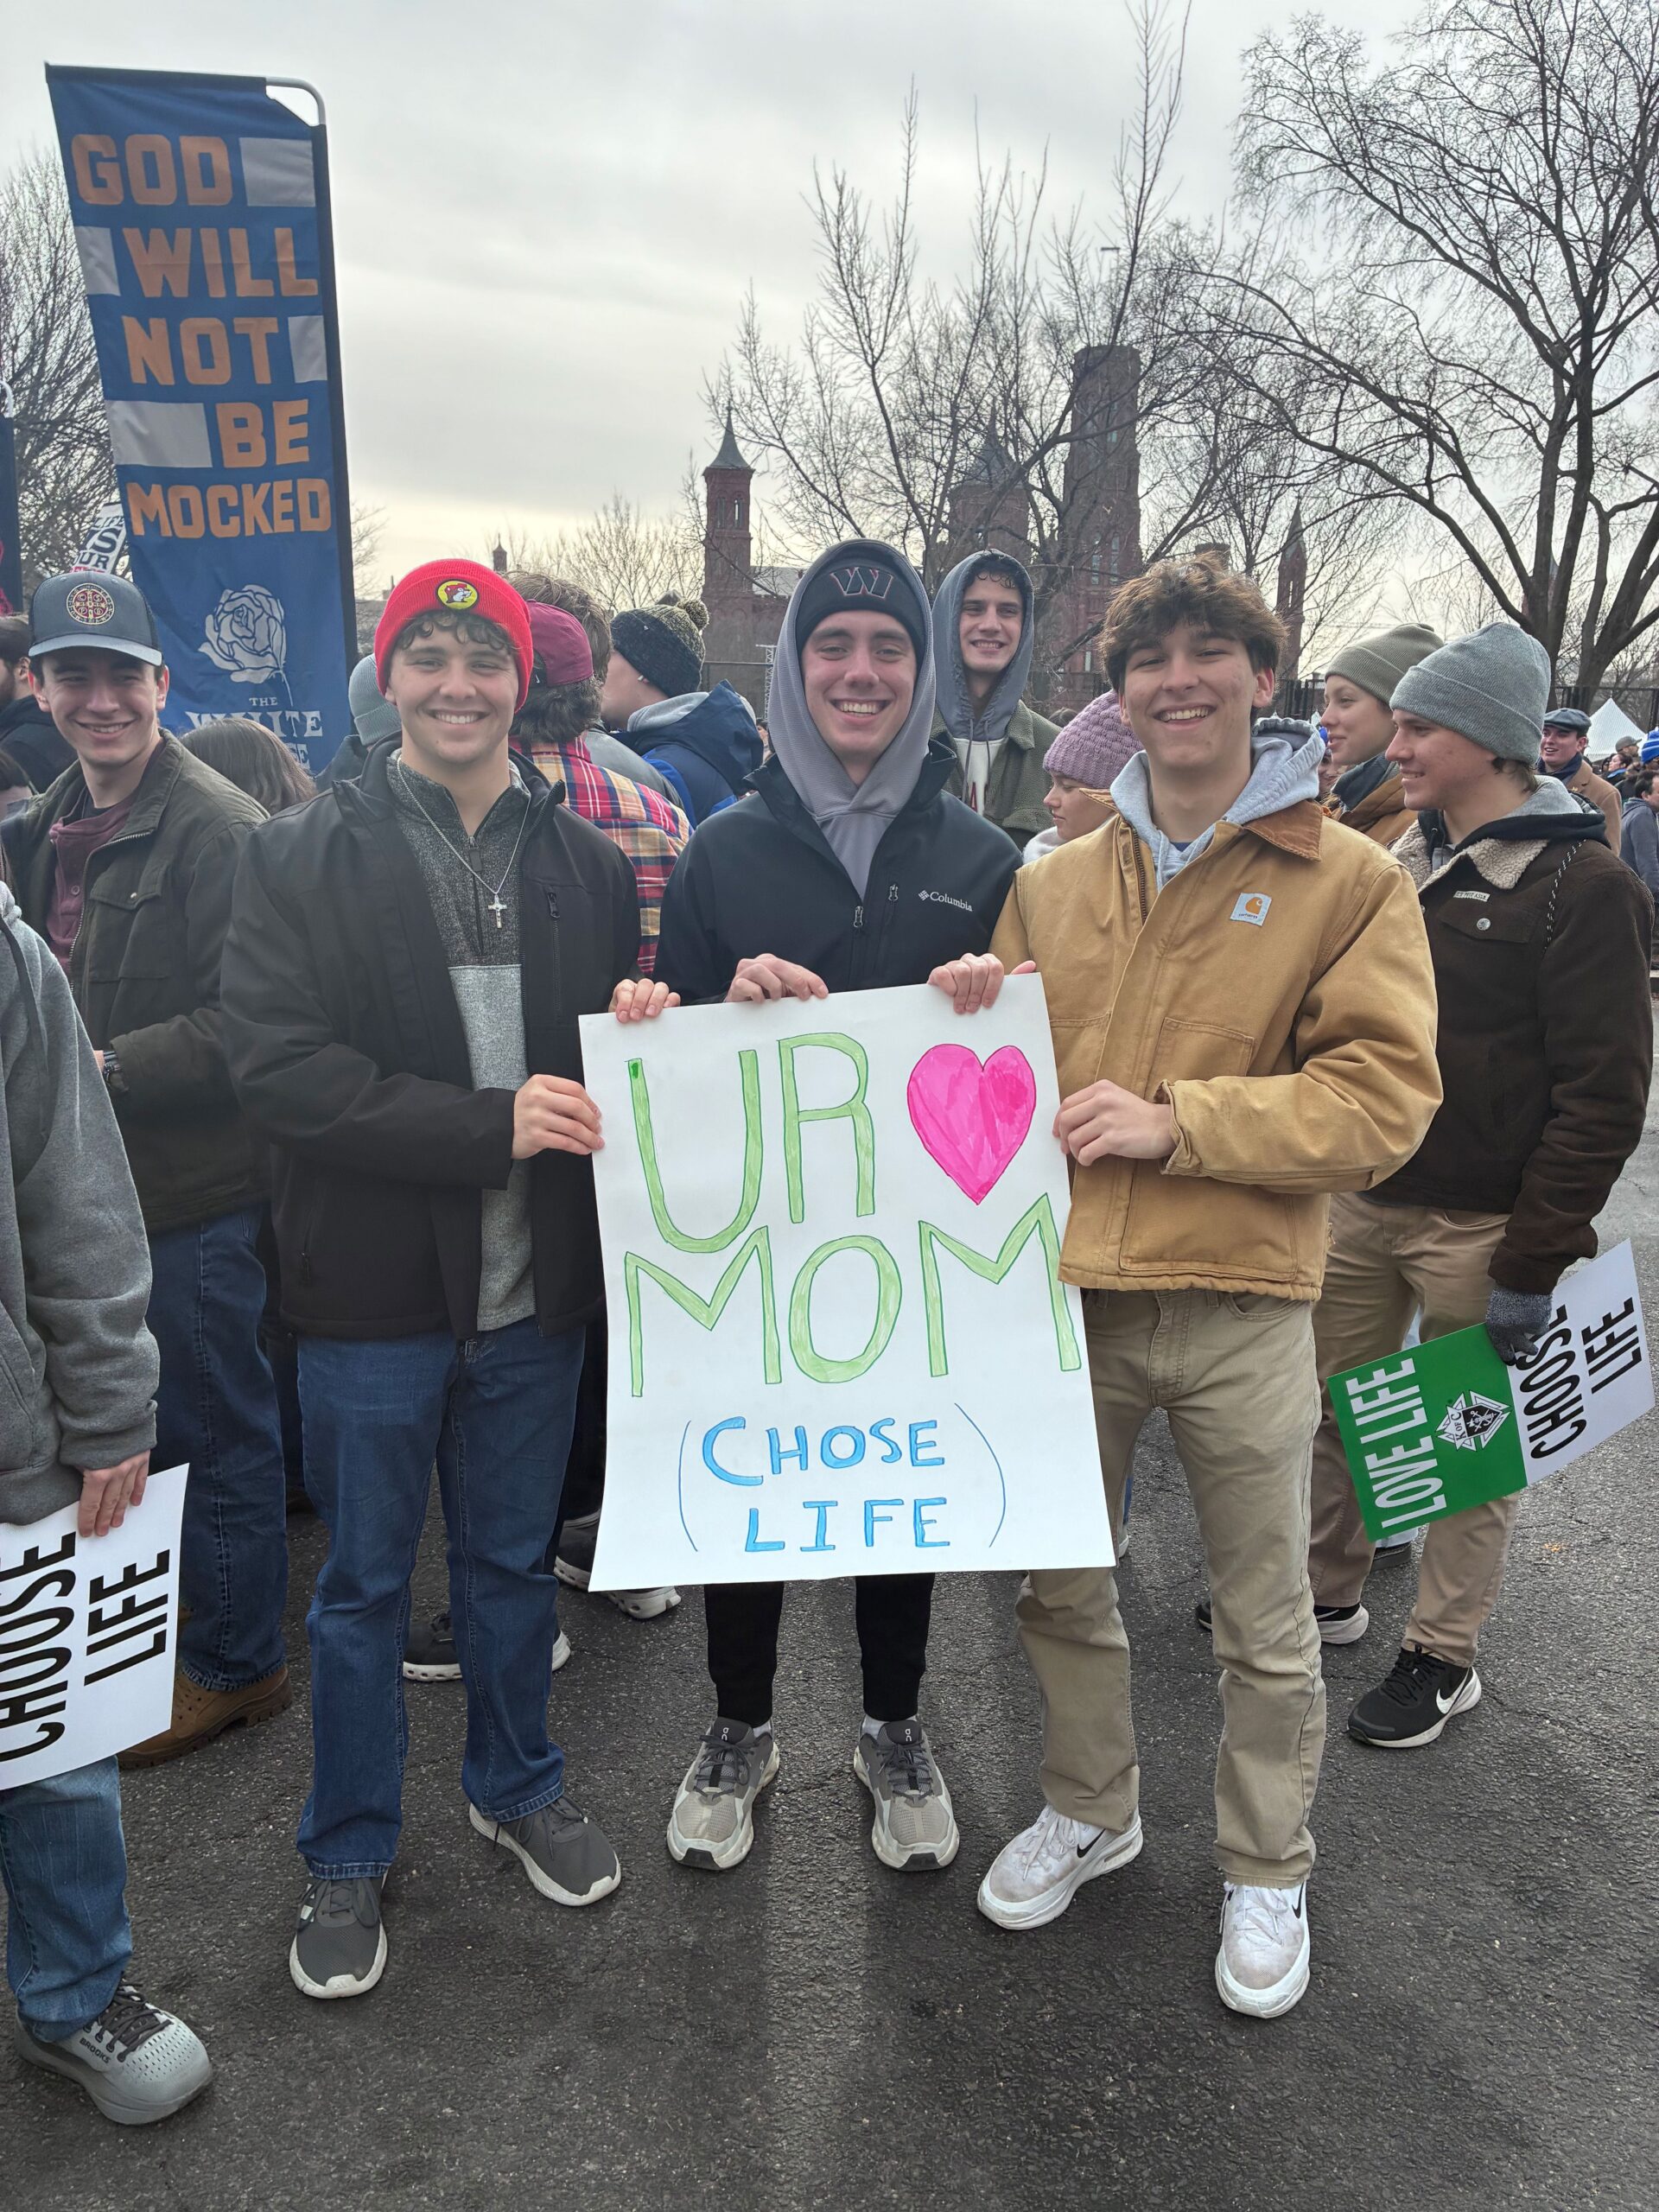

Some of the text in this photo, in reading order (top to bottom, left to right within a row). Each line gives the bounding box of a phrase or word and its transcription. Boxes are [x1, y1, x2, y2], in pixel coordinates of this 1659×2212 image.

[71, 134, 233, 206] GOD
[122, 227, 319, 298] WILL
[121, 315, 278, 385] NOT
[215, 398, 310, 468] BE
[125, 478, 332, 539] MOCKED
[184, 710, 323, 737] WITE
[249, 697, 278, 707] THE
[930, 891, 972, 912] Columbia
[625, 1032, 875, 1254] UR
[625, 1192, 1082, 1397] MOM
[1581, 1297, 1643, 1395] LIFE
[1345, 1357, 1447, 1529] LOVE LIFE
[84, 1548, 170, 1687] LIFE
[79, 2037, 111, 2064] BROOKS
